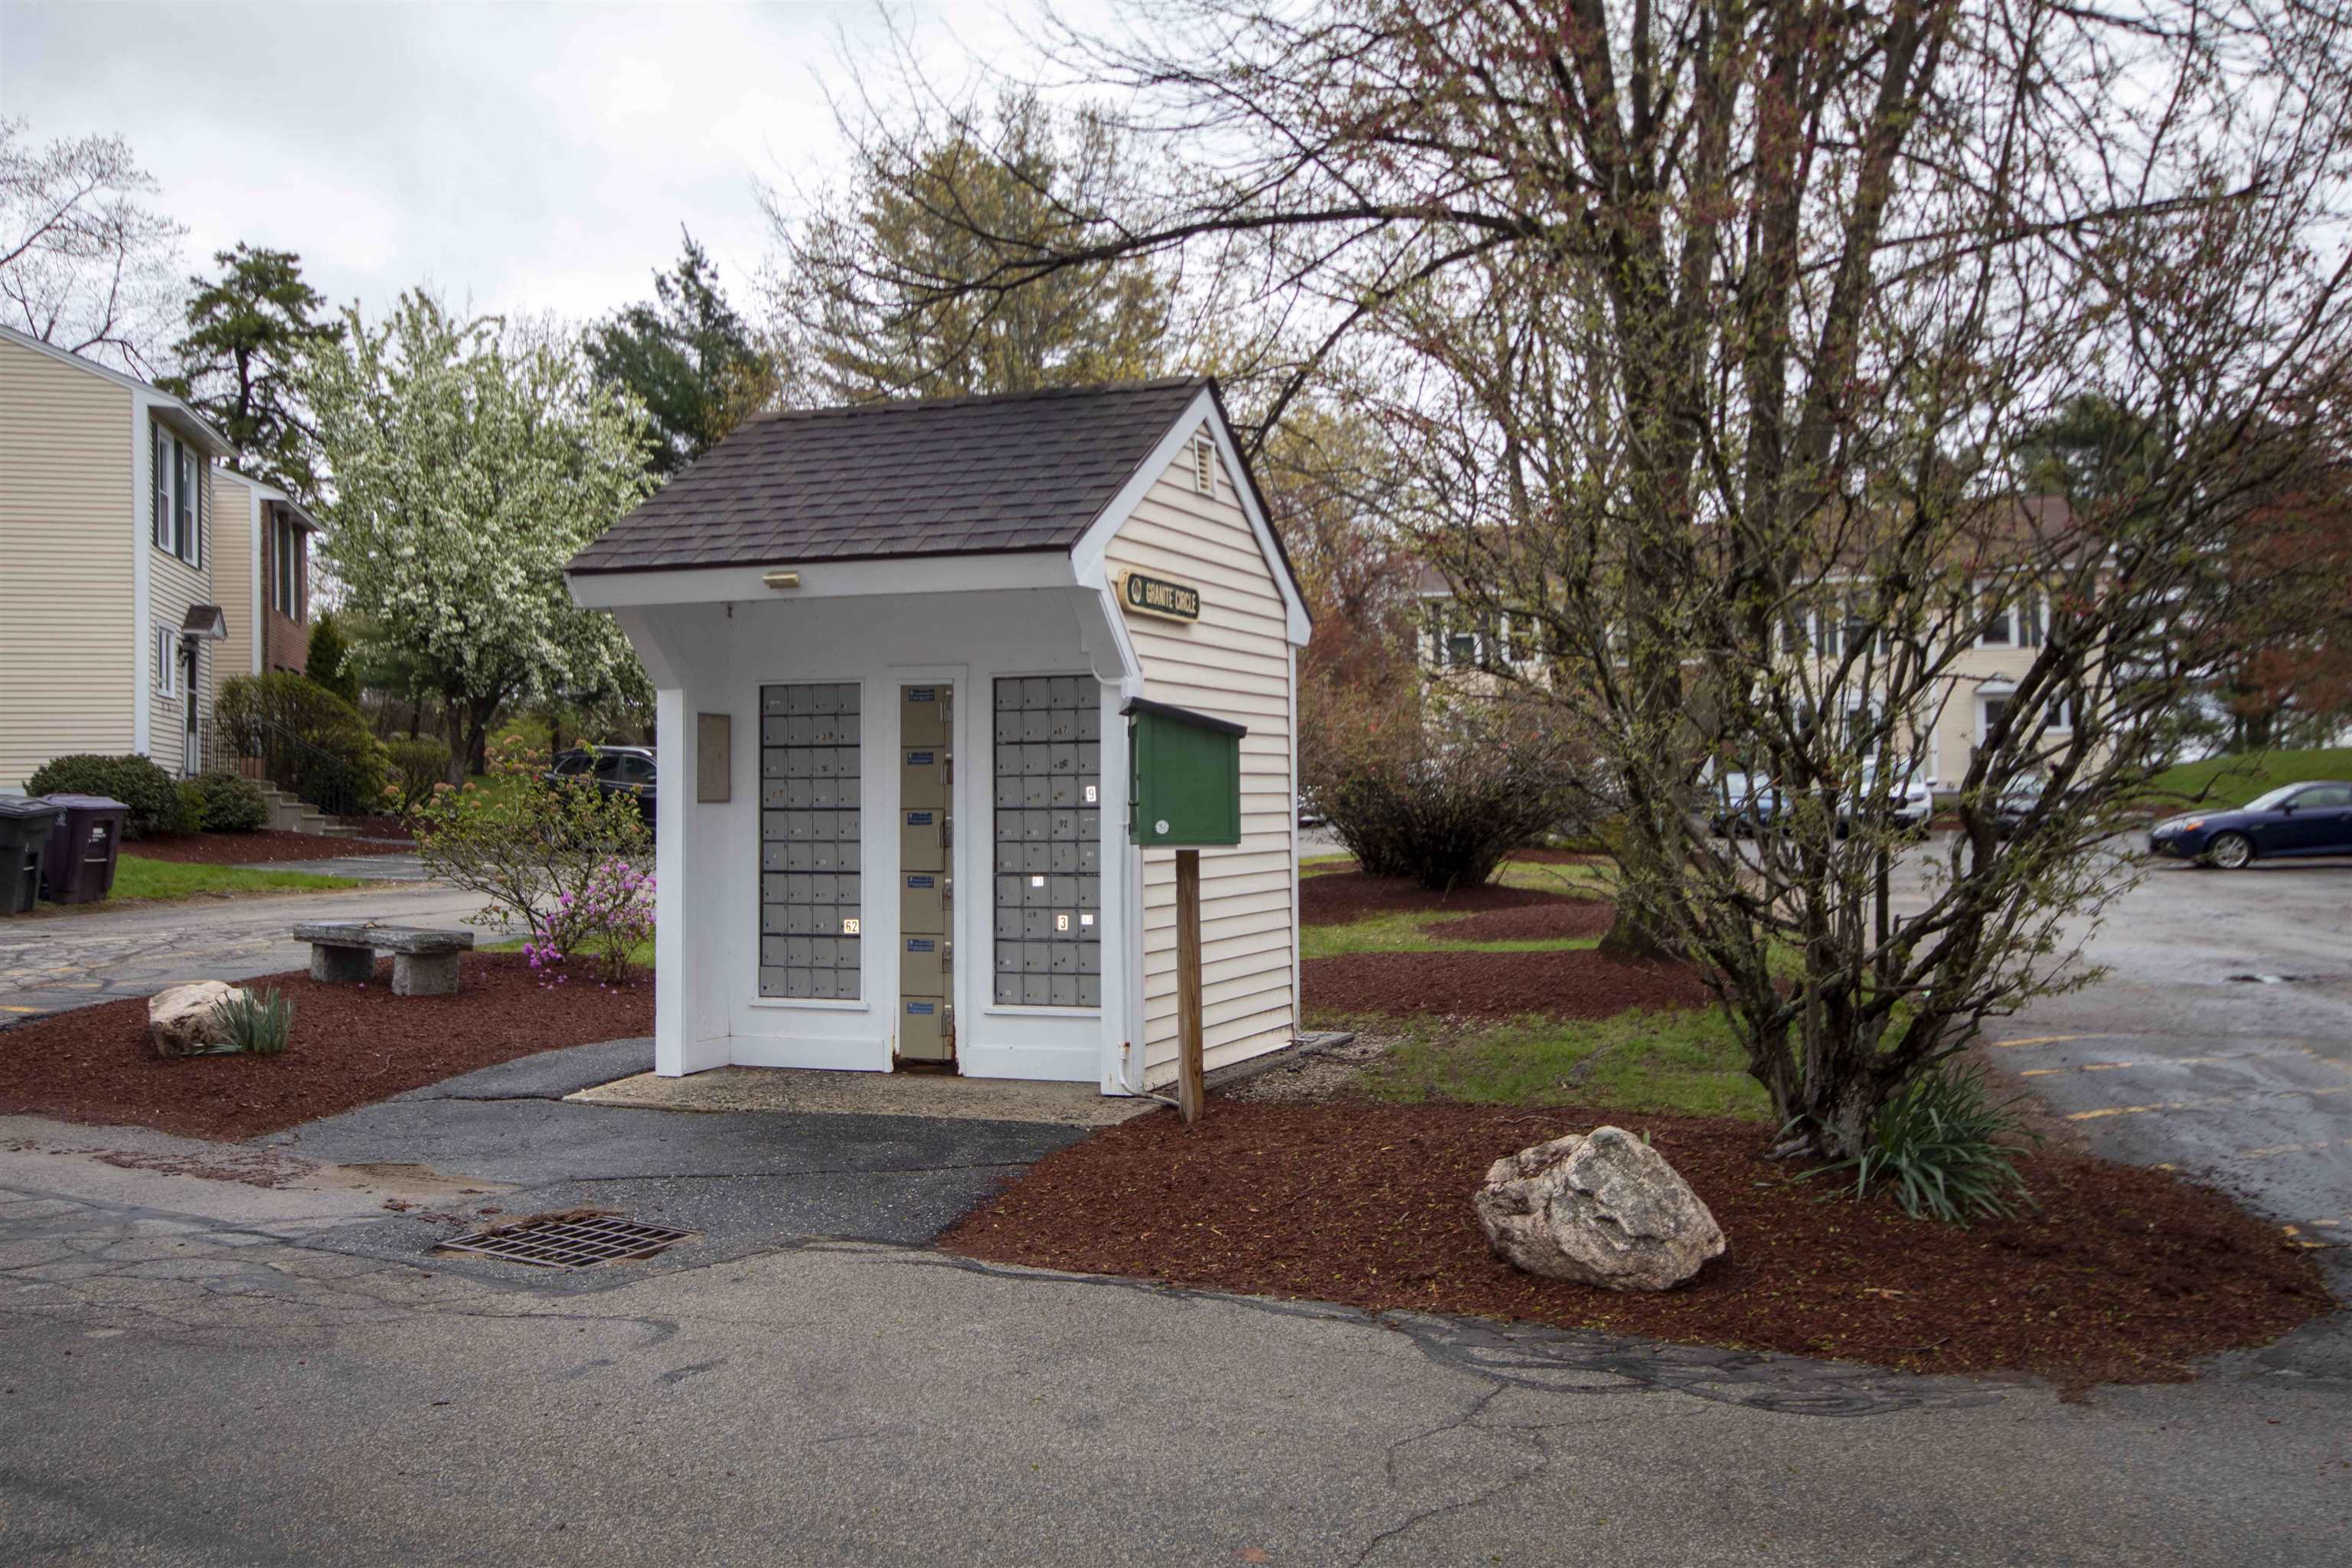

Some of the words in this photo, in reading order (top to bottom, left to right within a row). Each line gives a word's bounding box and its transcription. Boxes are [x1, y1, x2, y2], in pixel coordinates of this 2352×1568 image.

[1146, 582, 1174, 608] GRANITE
[1175, 590, 1197, 613] CIRCLE
[845, 920, 858, 933] 62
[1060, 916, 1067, 929] 3
